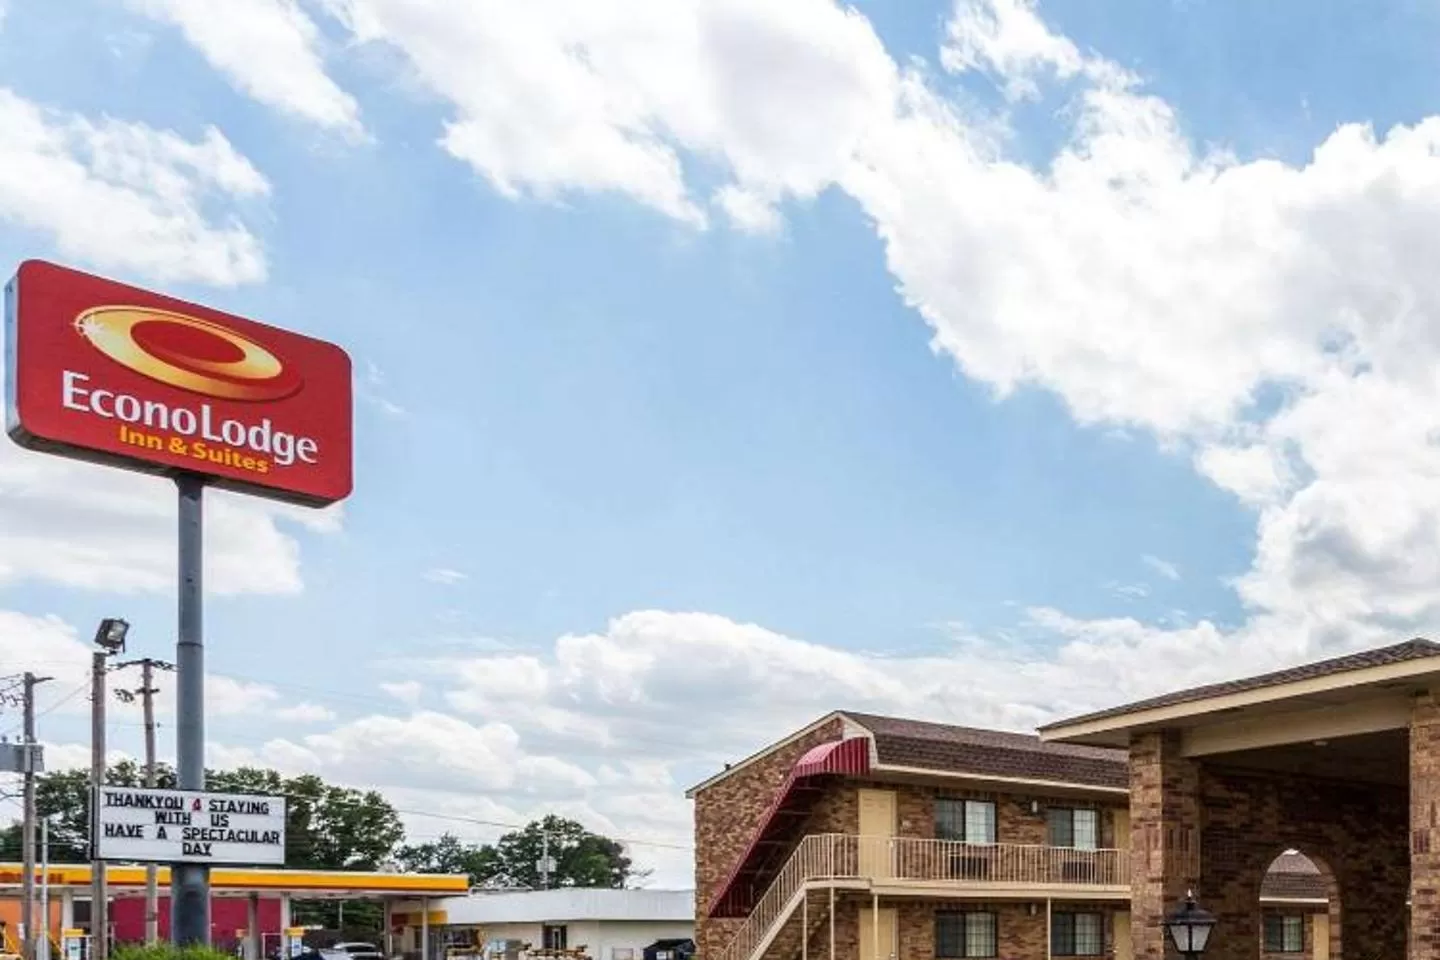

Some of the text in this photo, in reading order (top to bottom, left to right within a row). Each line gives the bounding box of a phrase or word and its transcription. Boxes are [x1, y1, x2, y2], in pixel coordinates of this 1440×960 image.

[61, 370, 319, 466] EconoLodge
[119, 425, 269, 474] Inn & Suites
[191, 799, 202, 812] 4
[209, 799, 269, 814] STAYING
[155, 811, 229, 828] WITH US
[105, 824, 280, 844] HAVE A SPECTACULAR
[182, 842, 212, 857] DAY
